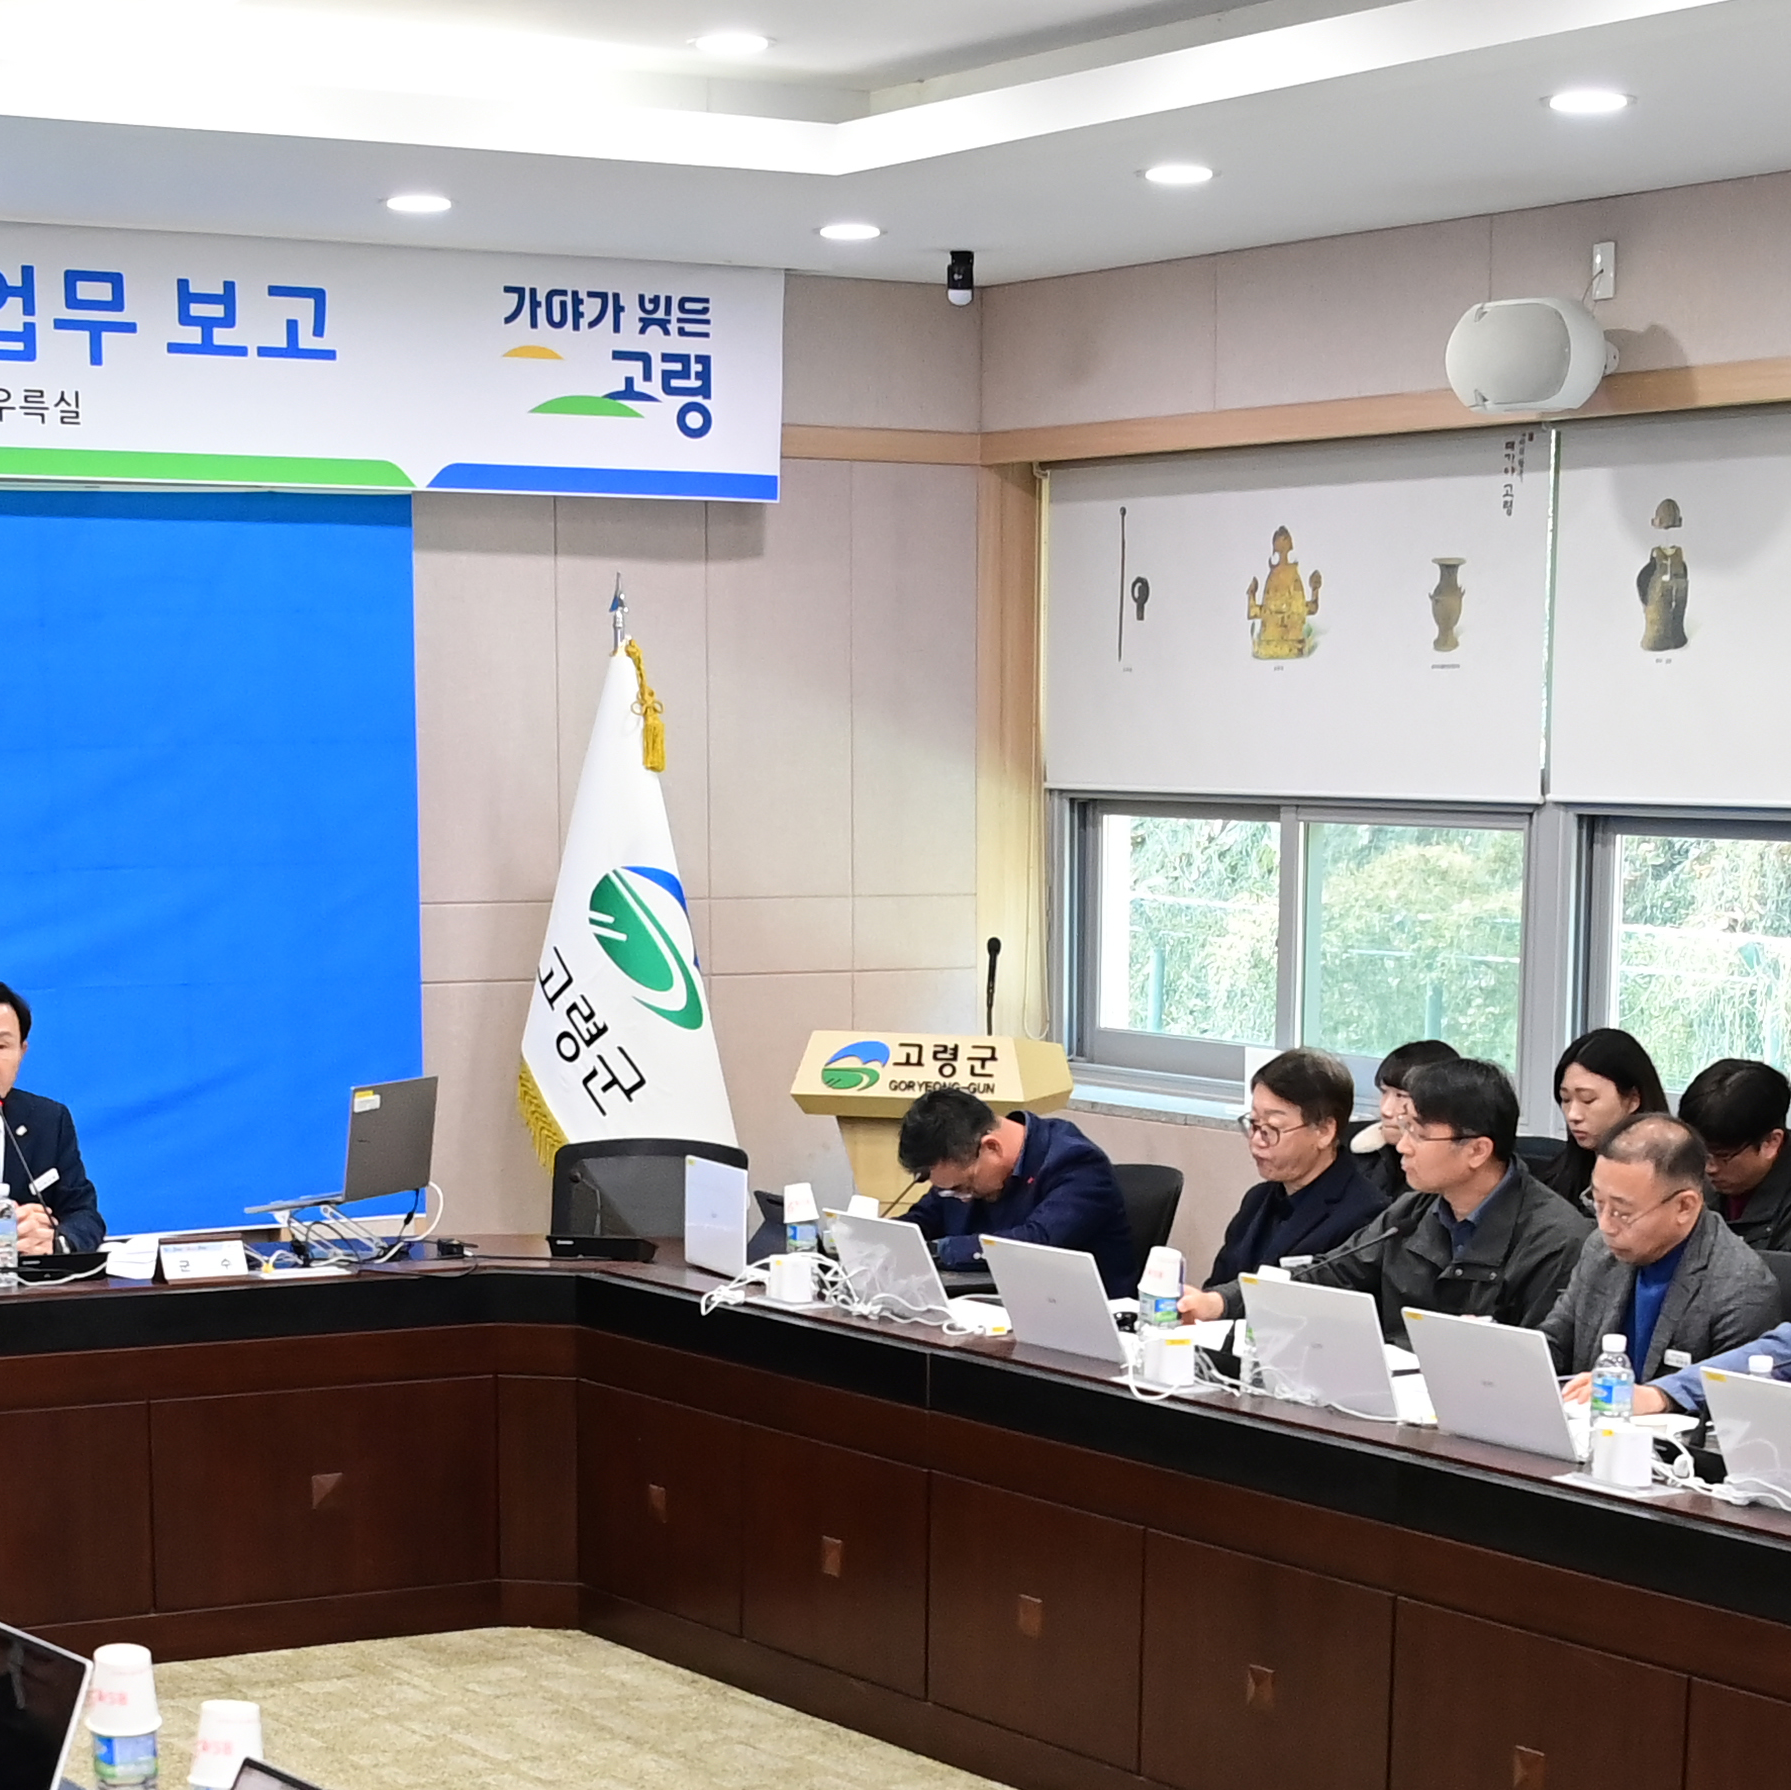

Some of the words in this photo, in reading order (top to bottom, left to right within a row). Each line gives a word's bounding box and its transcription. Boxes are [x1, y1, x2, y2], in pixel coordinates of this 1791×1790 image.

[165, 277, 338, 362] 보고
[503, 285, 626, 334] 가야가
[637, 293, 712, 339] 빚든
[601, 349, 713, 440] 고령
[537, 946, 647, 1116] 고령군
[892, 1042, 998, 1078] 고령군
